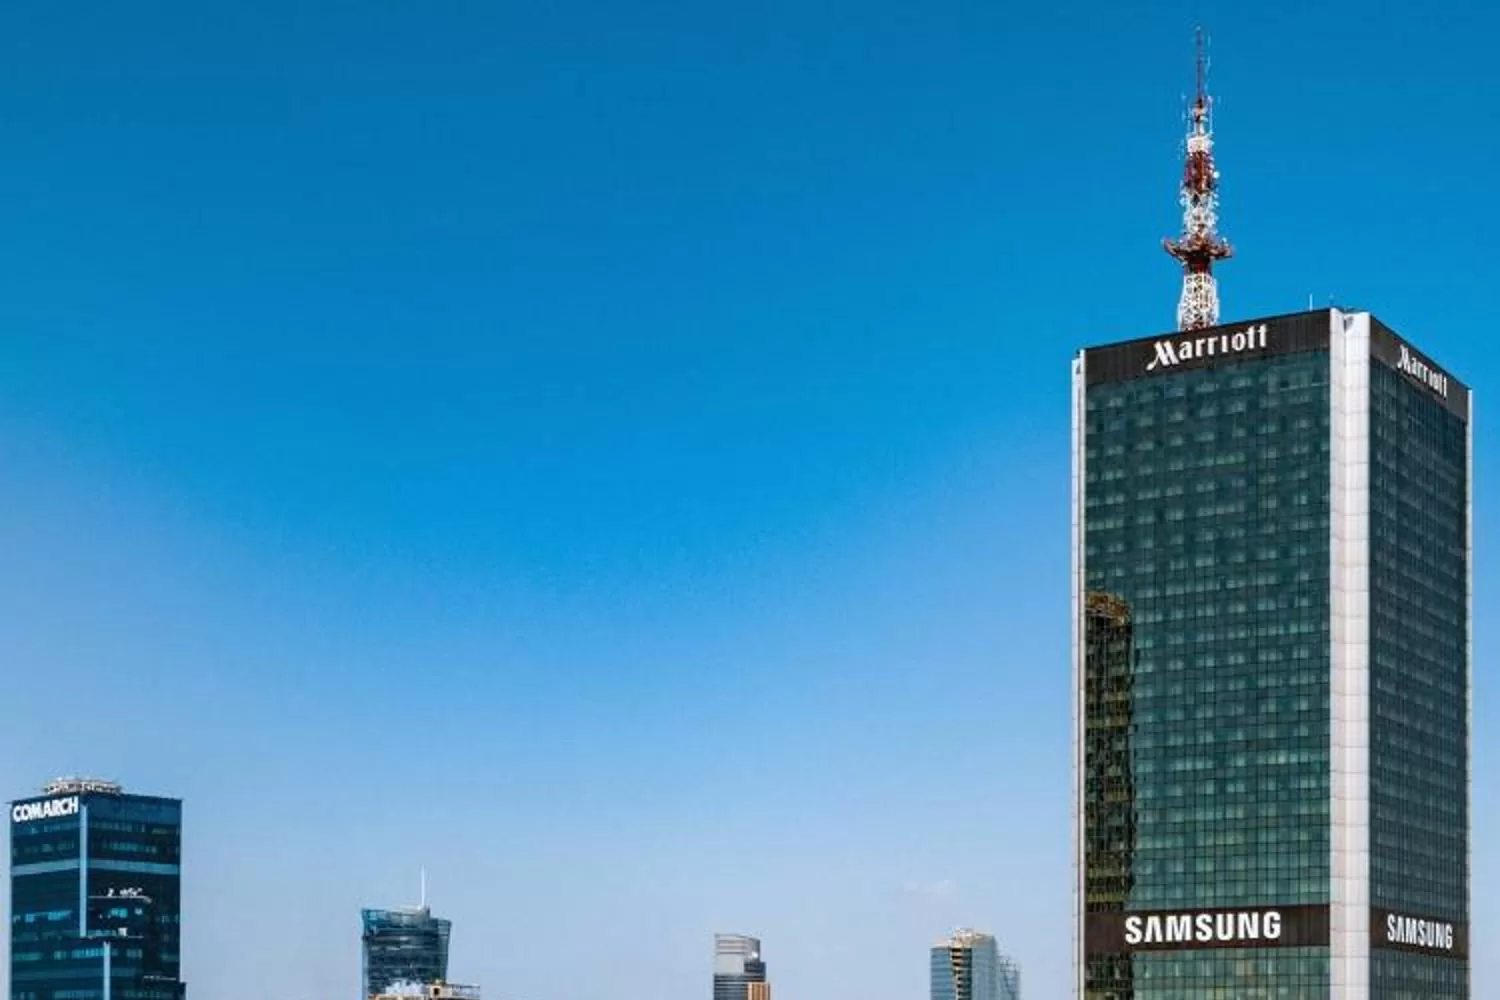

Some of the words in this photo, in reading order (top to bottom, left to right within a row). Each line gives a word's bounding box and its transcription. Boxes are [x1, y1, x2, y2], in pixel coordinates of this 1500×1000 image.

[1146, 324, 1267, 371] Marriott
[1397, 344, 1447, 398] Marriott
[13, 797, 79, 823] COMARCH
[1125, 911, 1281, 945] SAMSUNG
[1387, 913, 1453, 950] SAMSUNG
